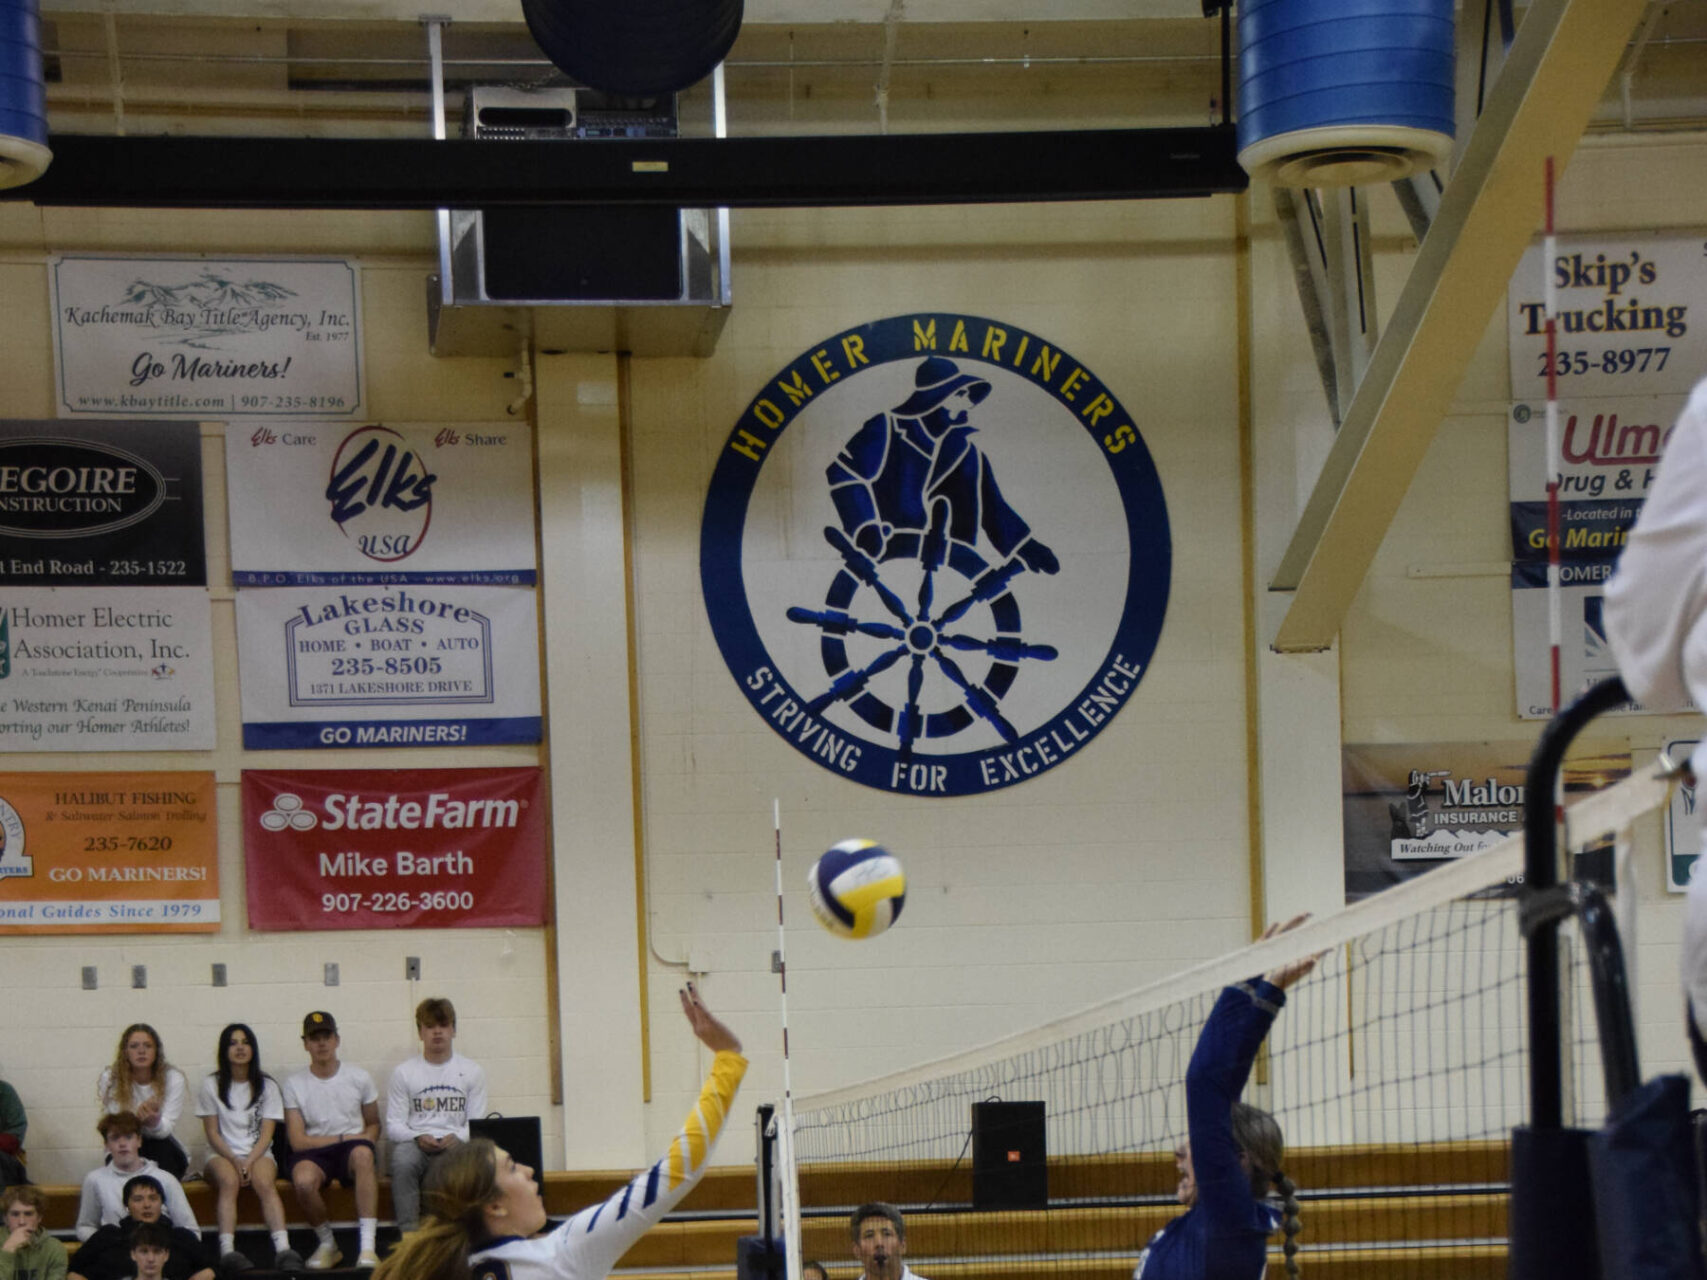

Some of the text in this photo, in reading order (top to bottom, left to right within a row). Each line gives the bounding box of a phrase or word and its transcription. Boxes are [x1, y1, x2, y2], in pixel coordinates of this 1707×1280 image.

[64, 305, 155, 327] Kachemak
[160, 308, 196, 330] Bay
[246, 307, 312, 331] Agency,
[318, 309, 350, 327] Inc.
[1519, 298, 1687, 338] Tucking
[129, 352, 292, 387] Go Mariners!
[731, 318, 1137, 462] HOMER MARINERS
[78, 394, 345, 409] www.kbaytitle.com 907-235-8196
[250, 426, 317, 447] Elks Care
[434, 427, 507, 447] Elks Share
[326, 438, 438, 523] Elks
[1614, 469, 1634, 490] &
[358, 534, 411, 555] usa
[11, 560, 44, 575] End
[50, 559, 94, 575] Road
[110, 560, 186, 576] 235-1522
[297, 572, 325, 584] Elks
[331, 572, 344, 584] of
[352, 572, 373, 583] the
[380, 571, 408, 583] USA
[425, 571, 520, 584] www.elks.org
[12, 607, 173, 628] Homer Electric
[297, 591, 472, 627] Lakeshore
[344, 617, 425, 636] GLASS
[14, 638, 190, 661] Association, Inc.
[300, 637, 479, 653] HOME BOAT AUTO
[332, 656, 442, 676] 235-8505
[310, 680, 473, 695] 1371 LAKESHORE DRIVE
[123, 695, 191, 713] Peninsula
[46, 723, 72, 733] our
[75, 717, 126, 734] Homer
[130, 716, 190, 734] Athletes!
[747, 654, 1141, 792] STRIVING FOR EXCELLENCE
[320, 726, 467, 744] GO MARINERS!
[55, 791, 197, 805] HALIBUT FISHING
[1434, 811, 1517, 825] INSURANCE
[84, 835, 173, 851] 235-7620
[1400, 842, 1451, 855] Watching
[1454, 842, 1474, 853] Out
[320, 851, 474, 876] Mike Barth
[50, 866, 206, 882] GO MARINERS!
[42, 905, 101, 919] Guides
[109, 904, 154, 917] Since
[162, 903, 202, 917] 1979
[322, 891, 474, 912] 907-226-3600
